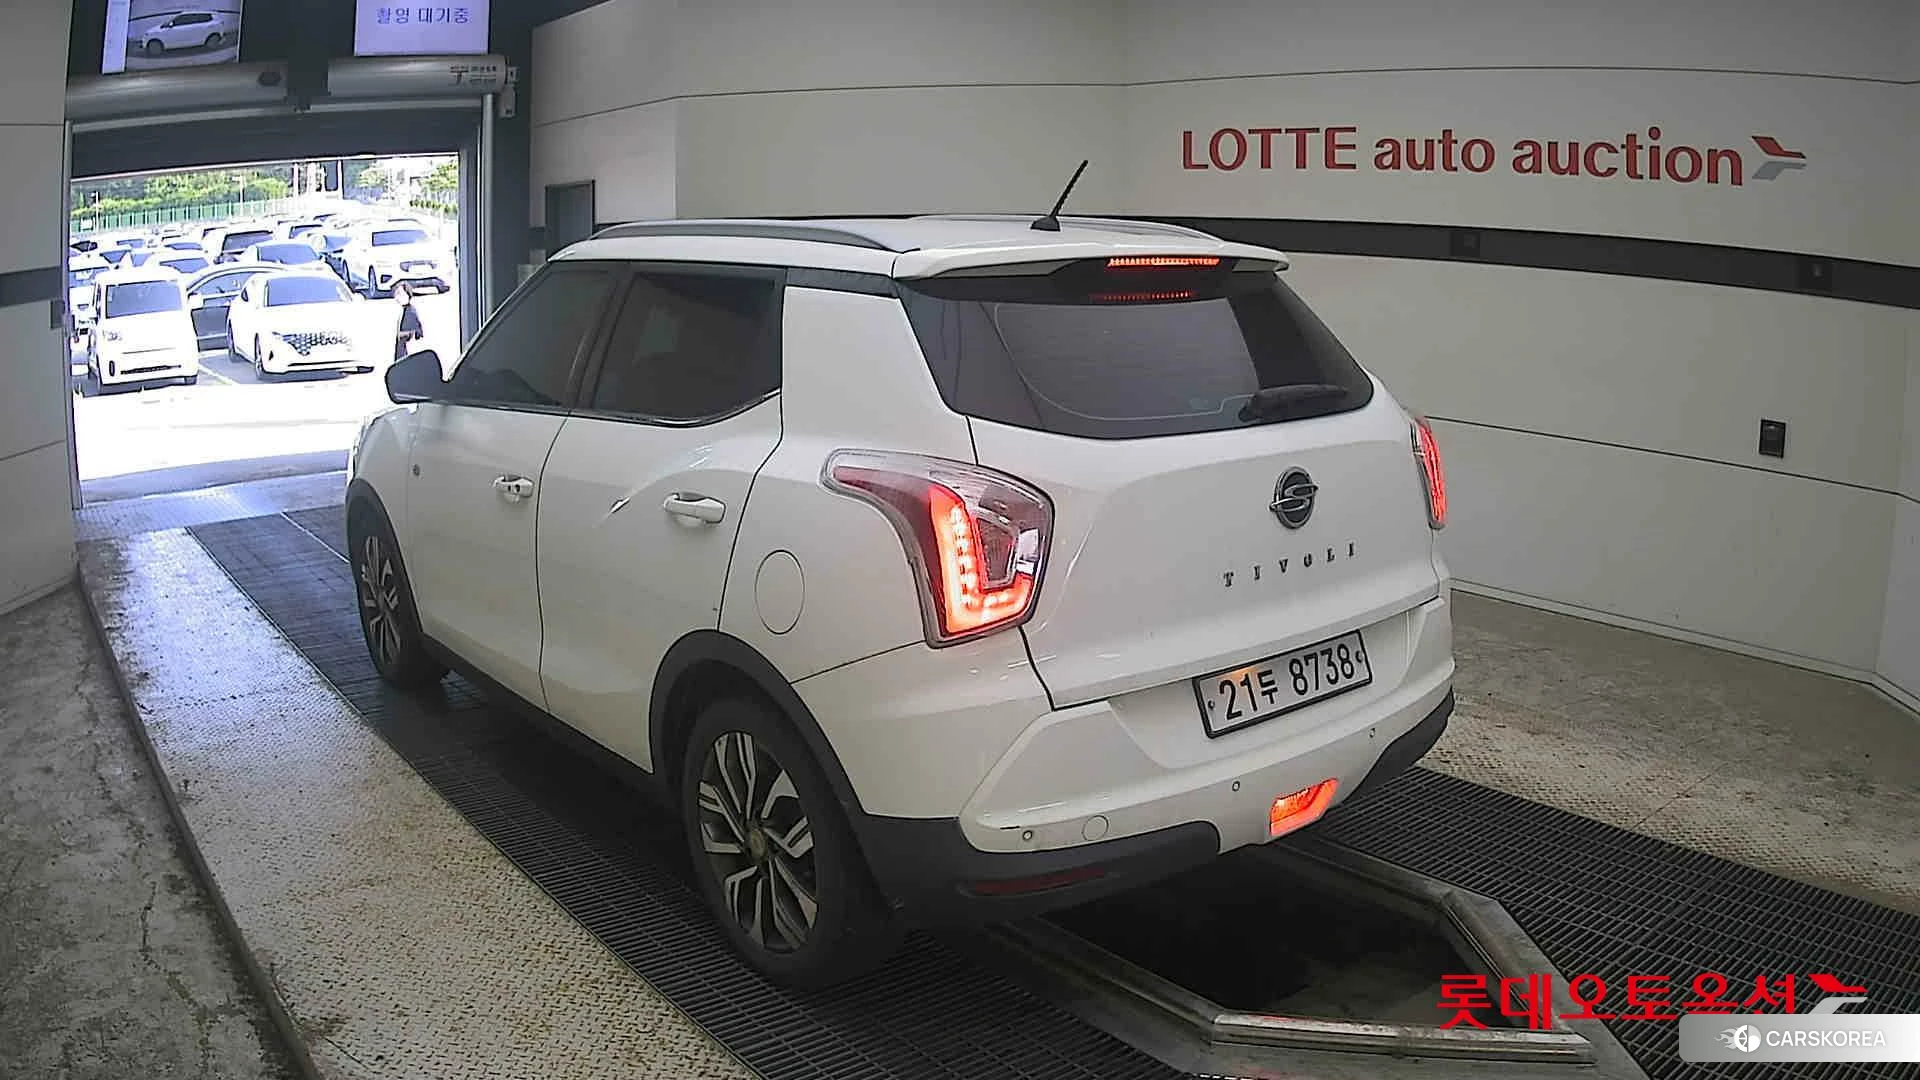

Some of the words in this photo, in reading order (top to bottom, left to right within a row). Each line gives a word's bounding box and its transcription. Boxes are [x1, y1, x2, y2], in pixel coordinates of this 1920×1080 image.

[418, 7, 469, 24] 대기중
[1181, 126, 1358, 171] LOTTE
[1373, 129, 1496, 173] auto
[1511, 126, 1744, 186] auction
[1223, 542, 1356, 587] TIVOLI
[1218, 668, 1279, 721] 21두
[1288, 643, 1355, 696] 8738
